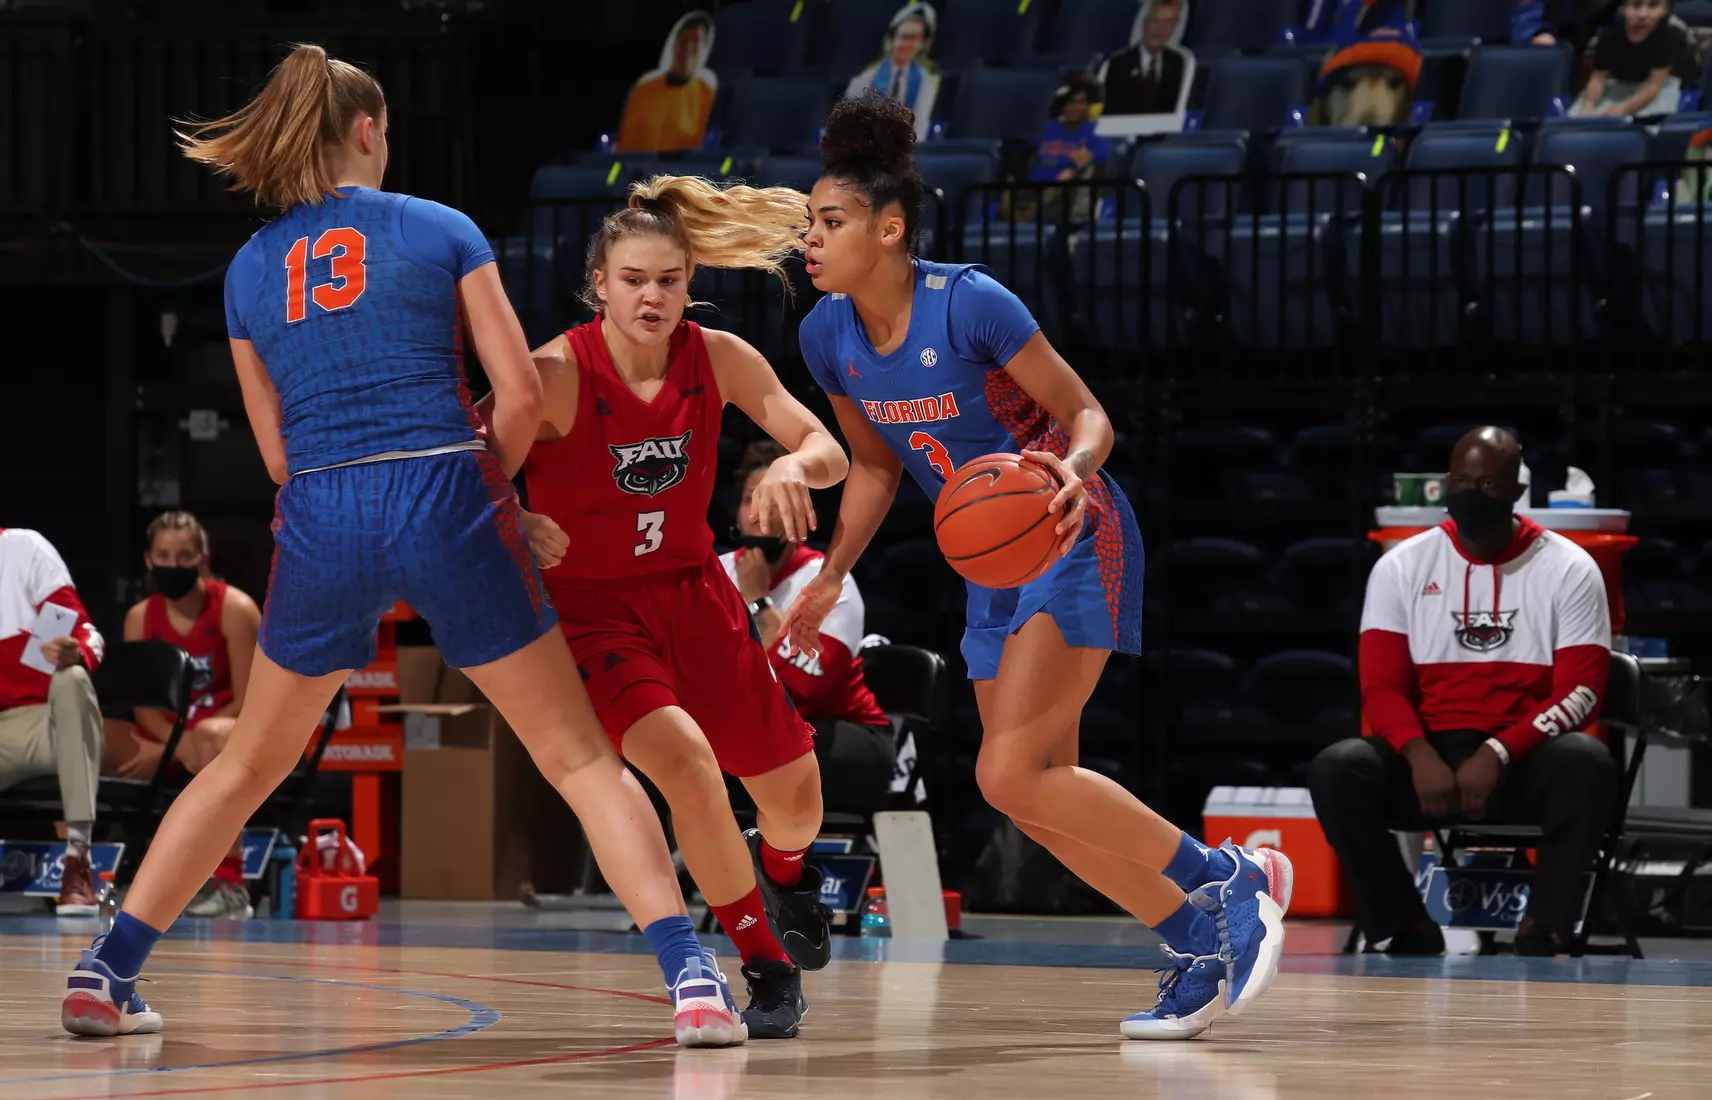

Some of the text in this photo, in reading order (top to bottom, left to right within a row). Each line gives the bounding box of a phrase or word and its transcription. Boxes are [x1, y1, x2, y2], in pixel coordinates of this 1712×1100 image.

[285, 226, 366, 323] 13
[860, 391, 960, 424] FLORIDA
[614, 438, 684, 472] FAU
[908, 430, 956, 481] 3
[634, 510, 665, 557] 3
[341, 885, 358, 912] G
[1480, 882, 1531, 918] VyS
